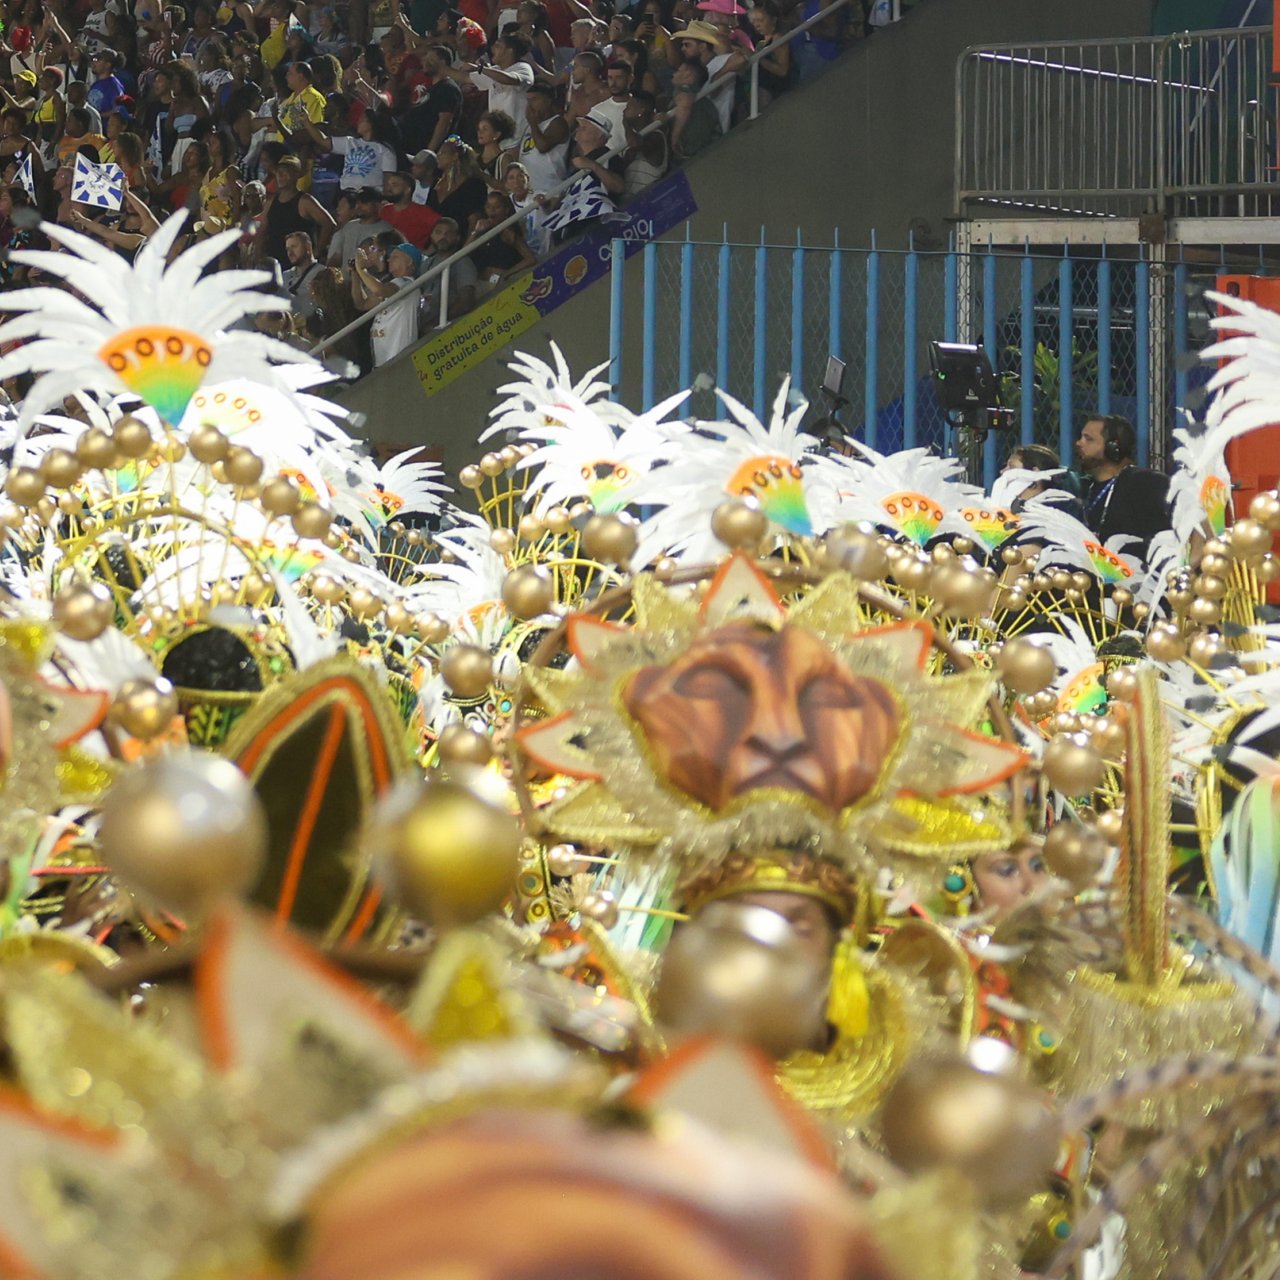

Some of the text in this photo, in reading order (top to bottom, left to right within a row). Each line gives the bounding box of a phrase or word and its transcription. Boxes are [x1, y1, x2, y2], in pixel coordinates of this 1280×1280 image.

[427, 315, 494, 365] Distribuição
[433, 311, 524, 381] gratuita de água
